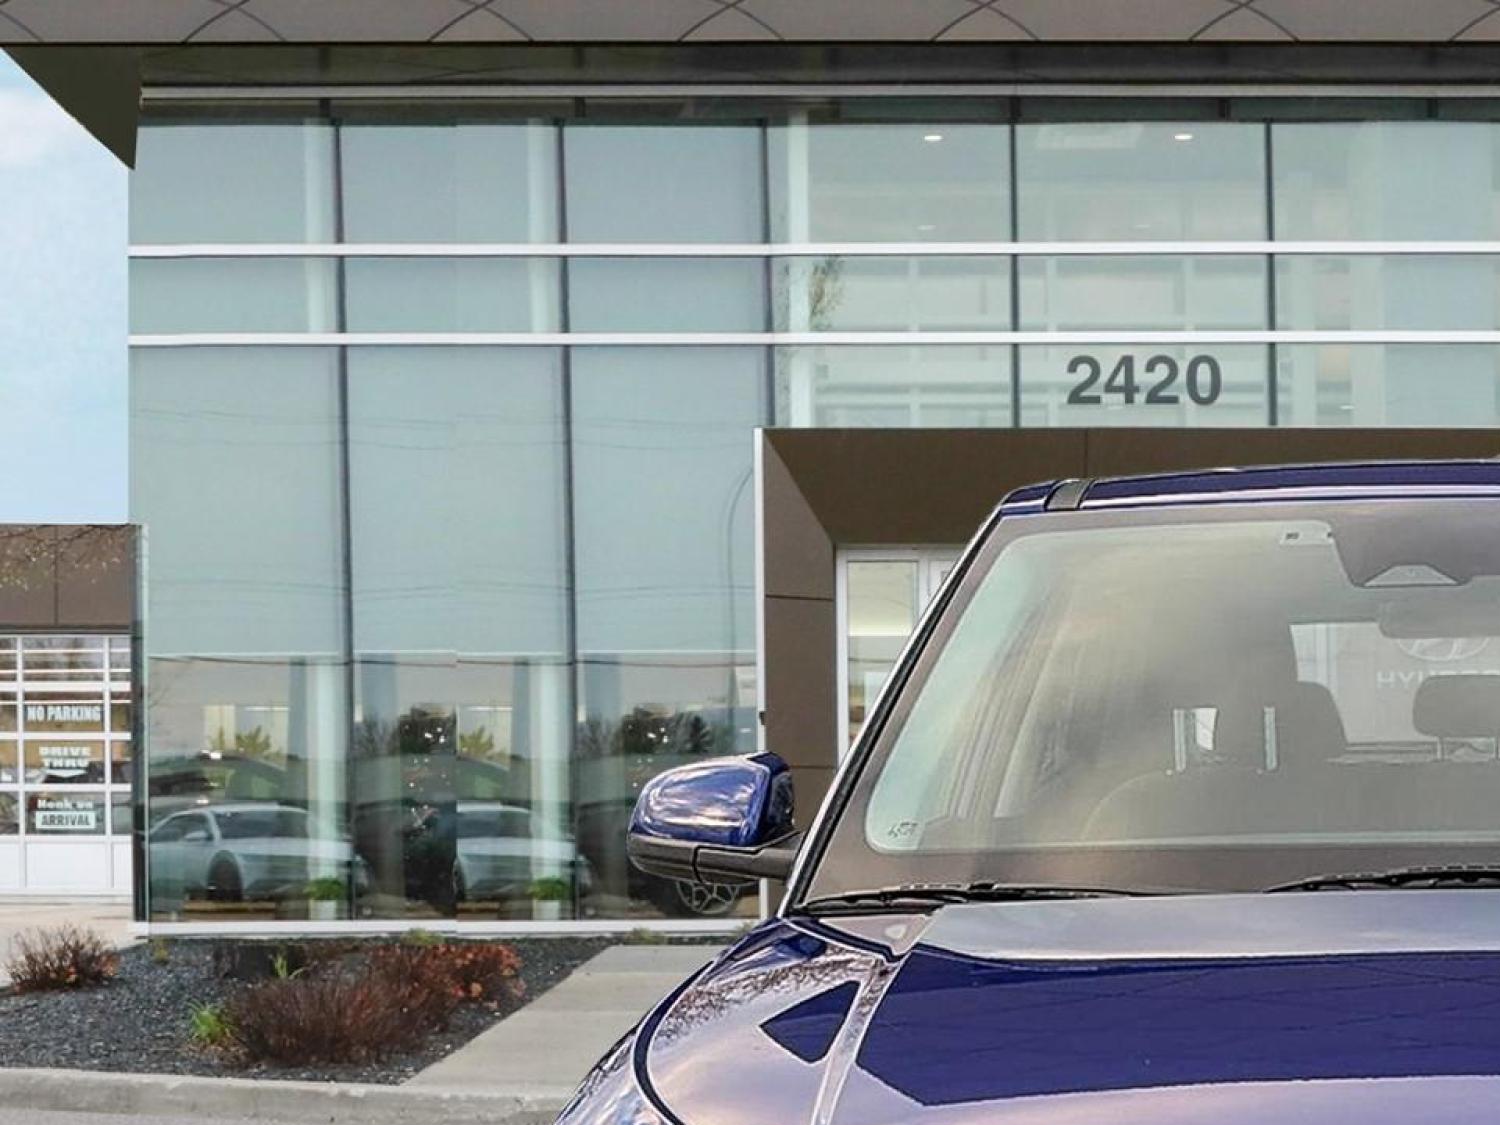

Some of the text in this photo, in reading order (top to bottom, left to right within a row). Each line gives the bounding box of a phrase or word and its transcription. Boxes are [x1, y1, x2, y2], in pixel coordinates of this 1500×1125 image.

[1066, 354, 1222, 406] 2420
[27, 705, 101, 721] NO PARKING
[39, 746, 91, 757] DRIVE
[43, 758, 90, 768] THRU
[41, 813, 91, 826] ARRIVAL
